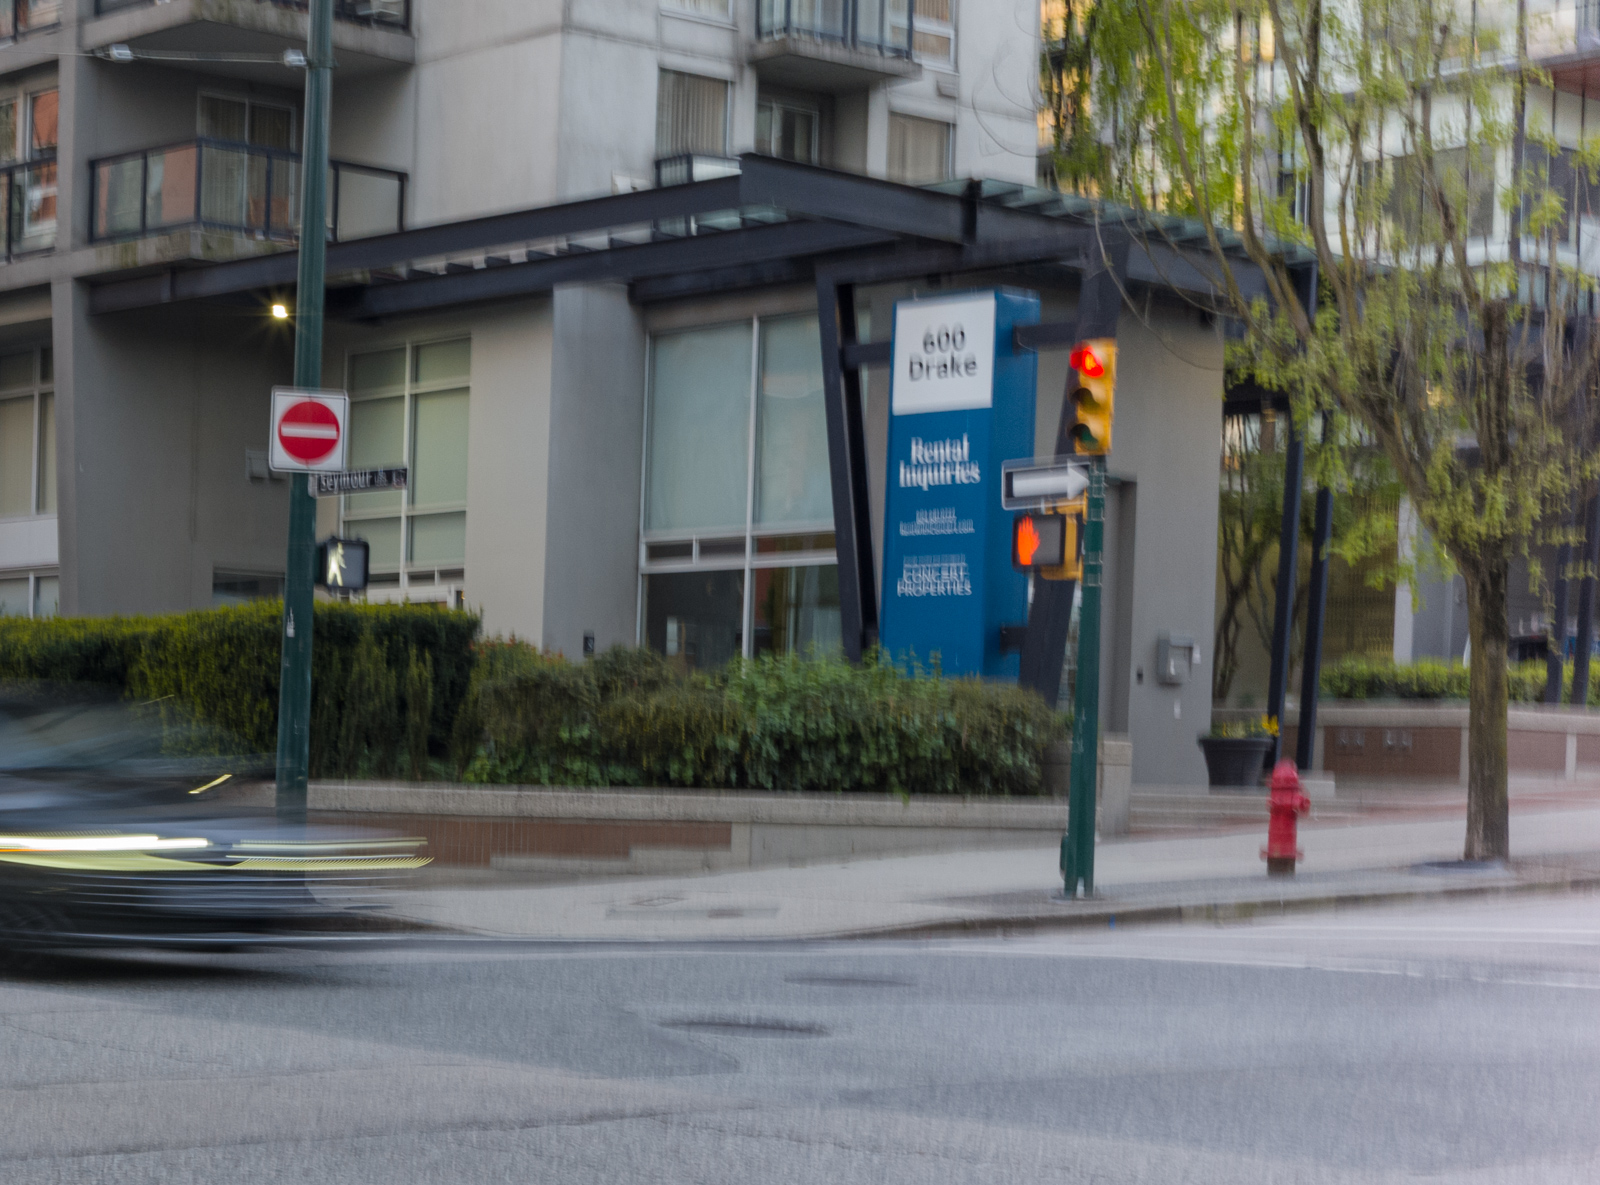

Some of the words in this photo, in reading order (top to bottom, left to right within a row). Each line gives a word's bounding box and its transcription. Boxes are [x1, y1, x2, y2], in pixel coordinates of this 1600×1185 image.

[922, 324, 967, 355] 600
[909, 351, 977, 382] Drake
[911, 432, 970, 465] Rental
[899, 460, 981, 491] Inquiries
[897, 578, 972, 597] PROPERTIES
